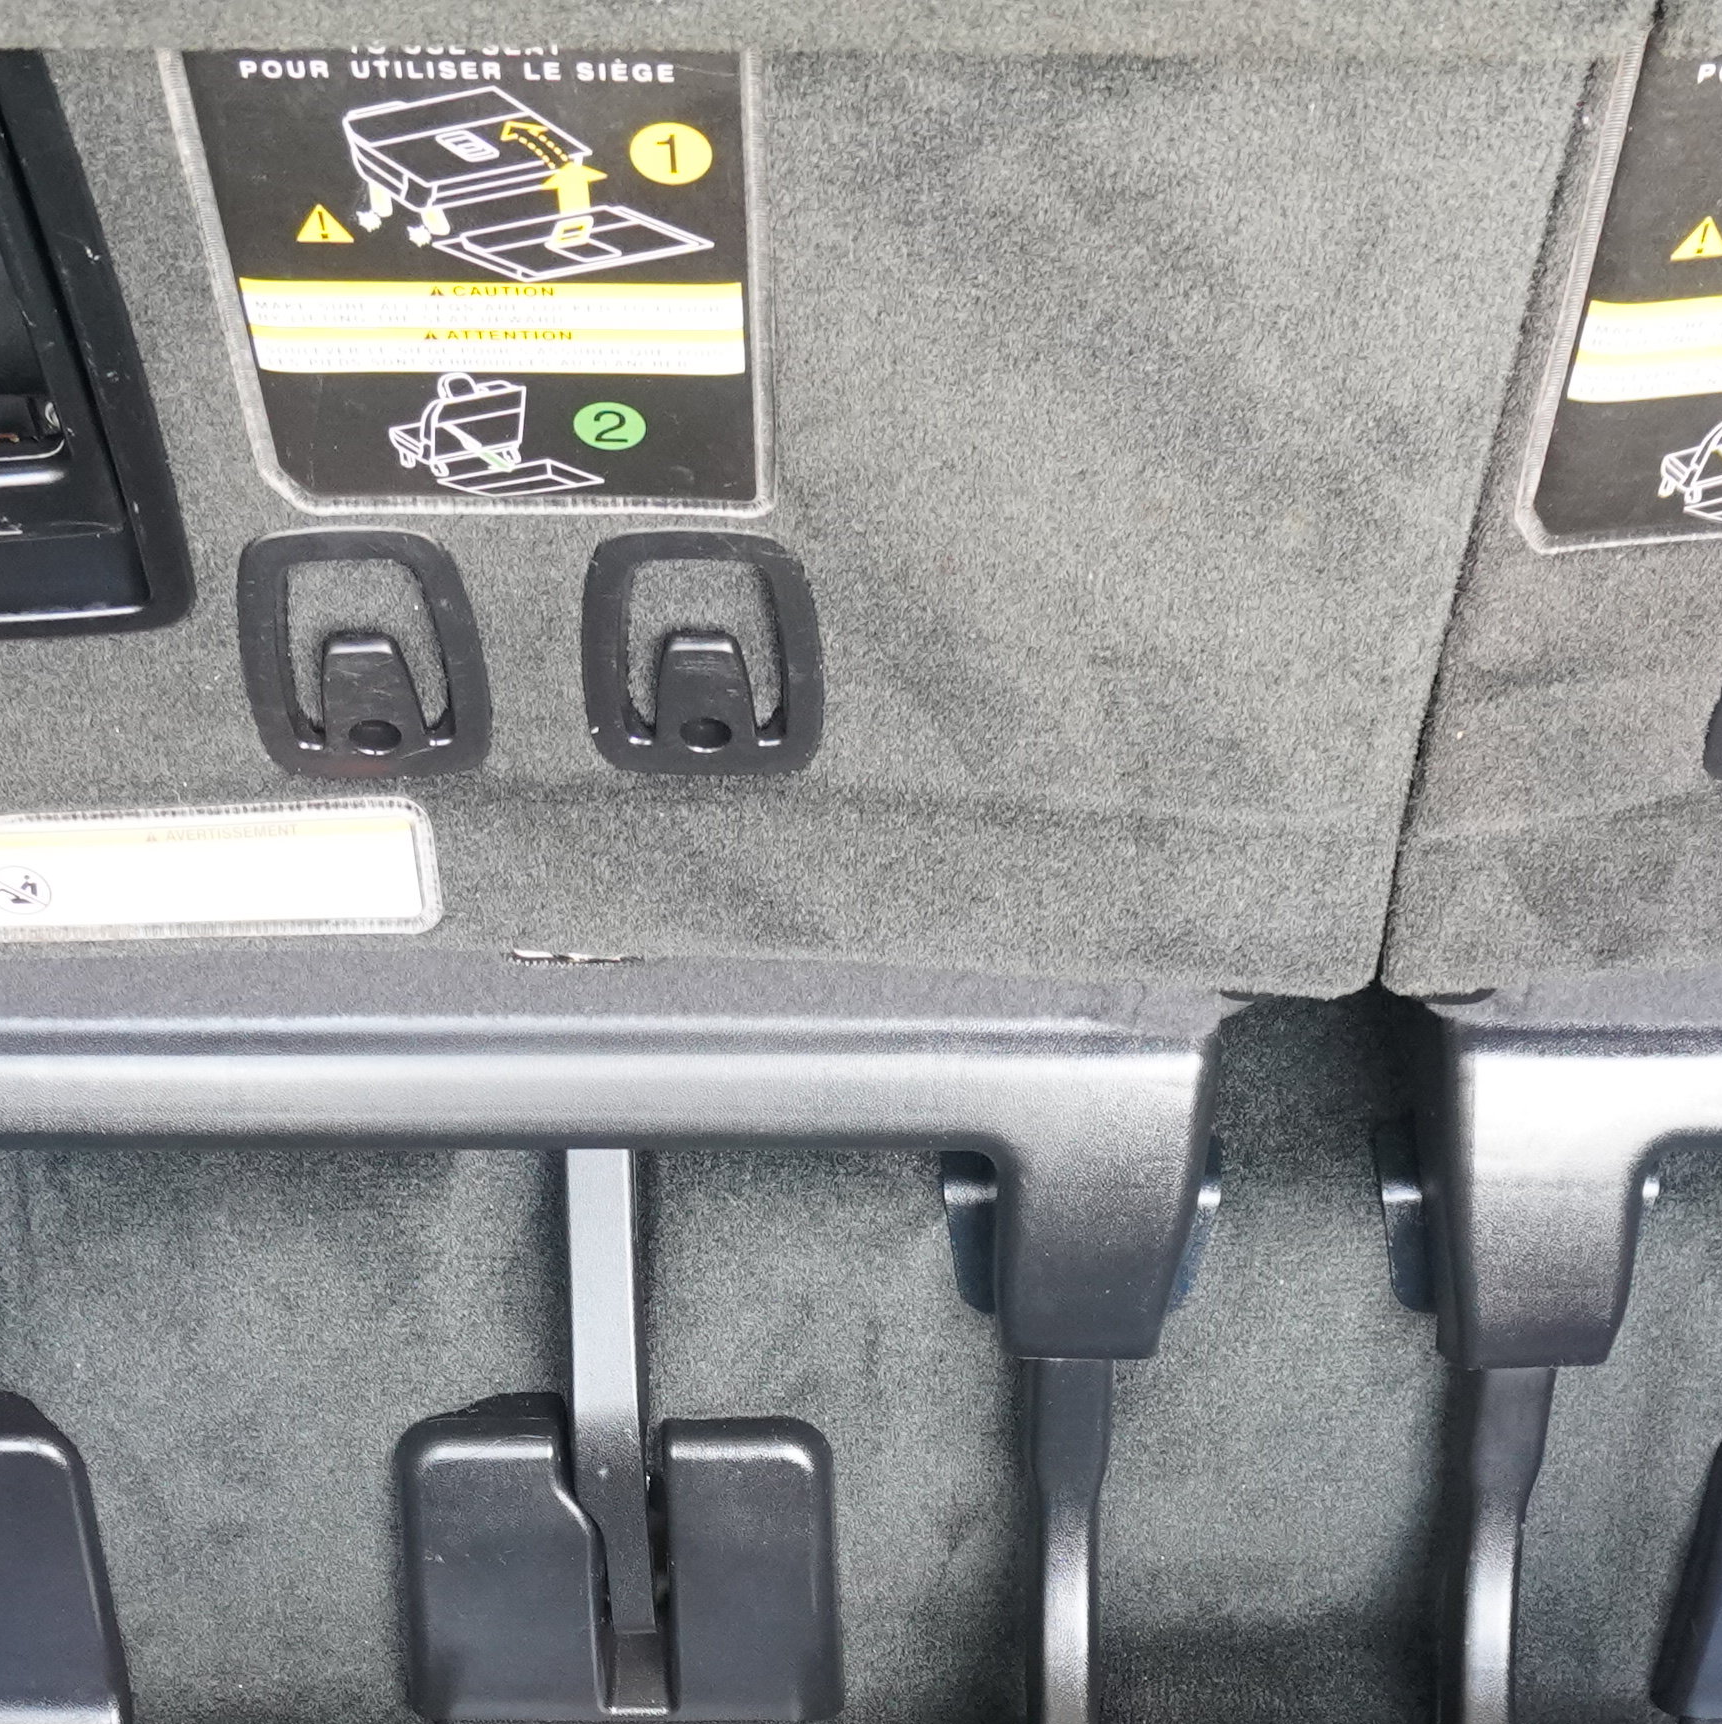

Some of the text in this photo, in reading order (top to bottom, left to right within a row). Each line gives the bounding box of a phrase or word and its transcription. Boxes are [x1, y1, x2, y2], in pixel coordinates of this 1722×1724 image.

[238, 57, 677, 84] POUR UTILISER LE SIÈGE
[656, 133, 679, 175] 1
[452, 286, 555, 297] CAUTION
[446, 330, 573, 341] ATTENTION
[592, 410, 629, 445] 2
[165, 823, 298, 842] AVERTISSEMENT
